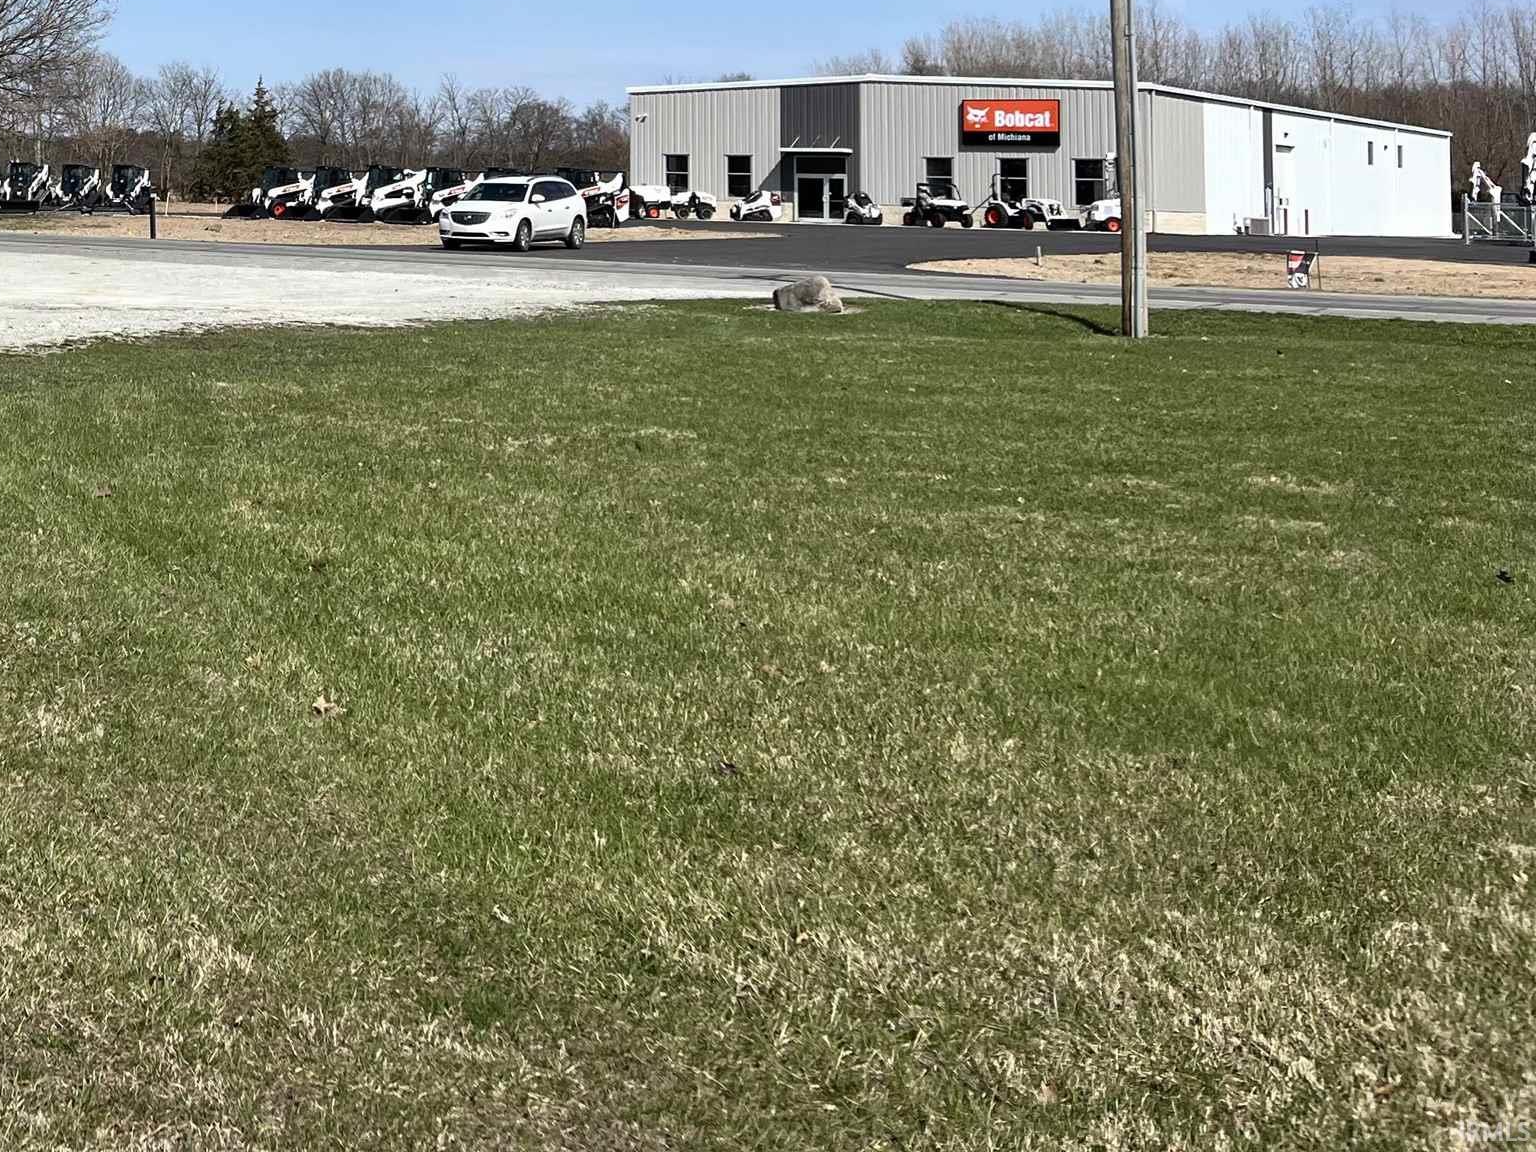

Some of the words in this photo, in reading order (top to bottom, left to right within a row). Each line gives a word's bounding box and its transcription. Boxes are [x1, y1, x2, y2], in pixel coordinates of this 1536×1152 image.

[994, 111, 1051, 127] Bobcat
[988, 133, 996, 141] of
[997, 133, 1031, 141] Michiana
